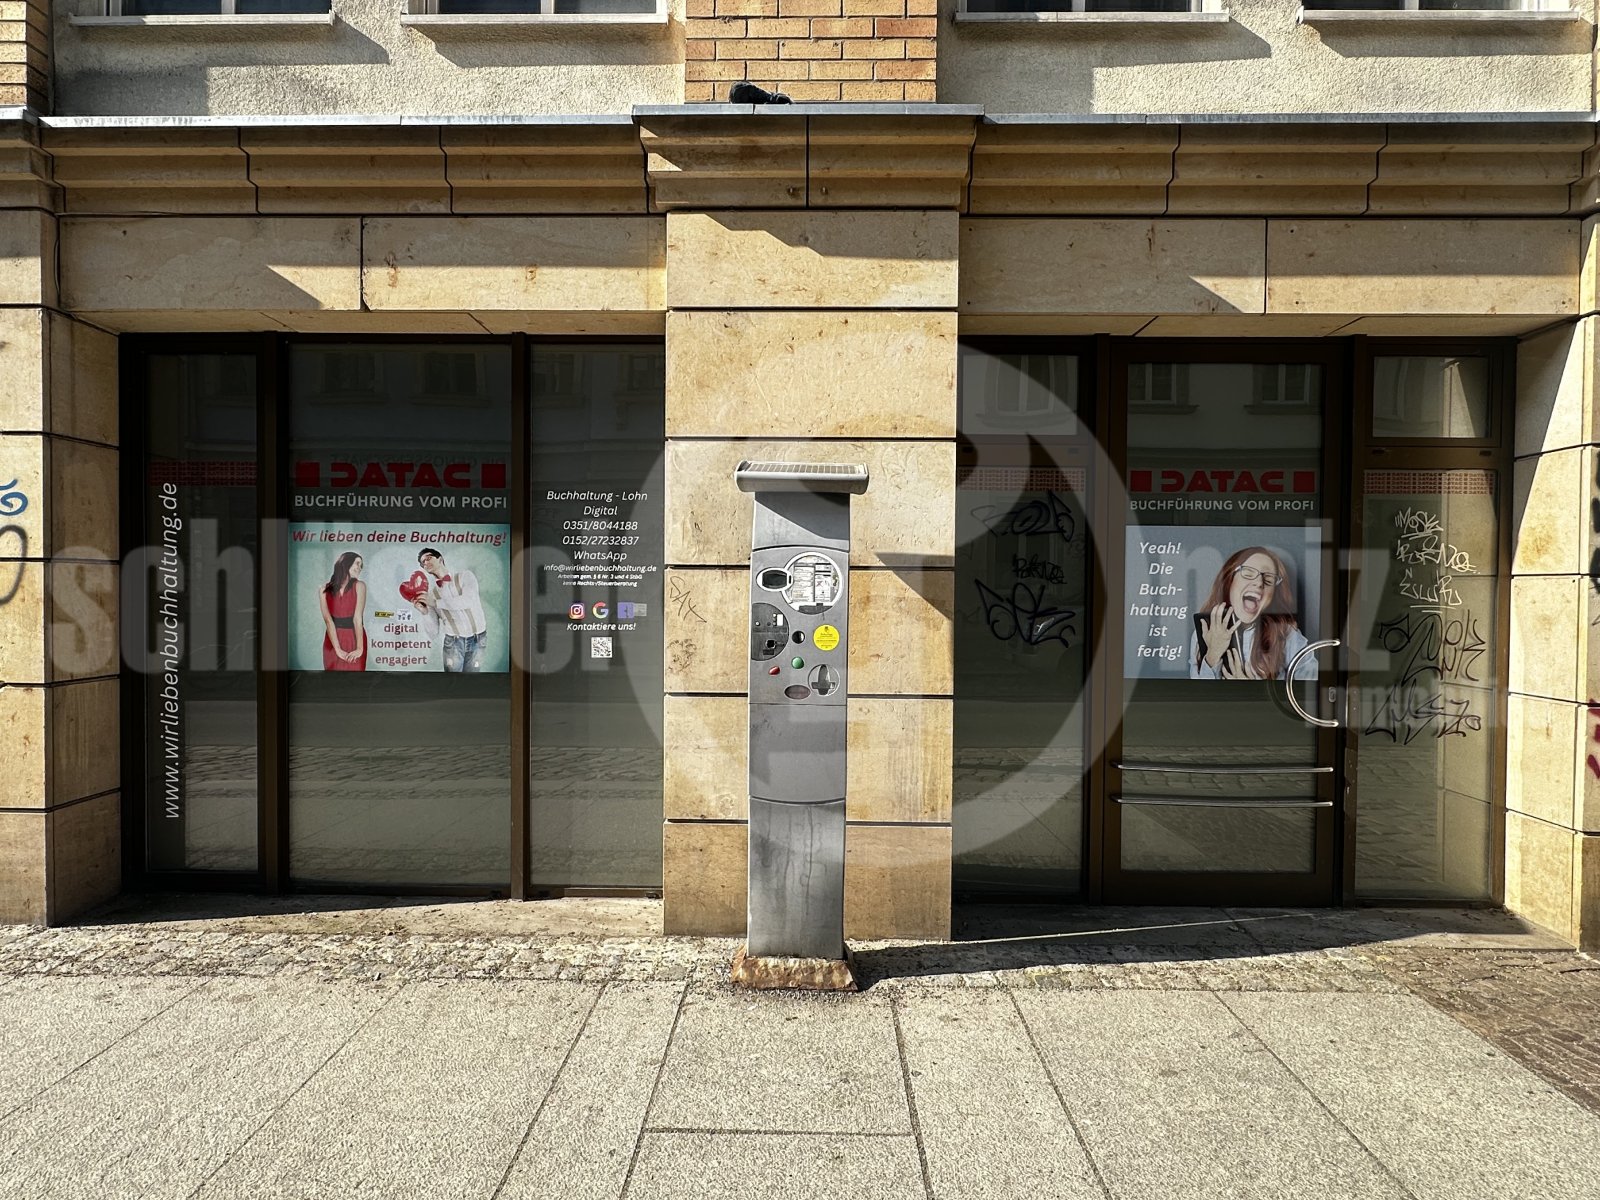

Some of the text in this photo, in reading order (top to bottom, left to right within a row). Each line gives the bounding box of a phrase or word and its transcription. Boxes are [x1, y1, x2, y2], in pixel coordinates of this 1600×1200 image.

[331, 463, 471, 488] DATAC
[1161, 471, 1284, 493] DATAC
[295, 493, 507, 508] BUCHFÜHRUNG VOM PROFI
[546, 491, 613, 502] Buchhaltung
[622, 491, 648, 501] Lohn
[1130, 498, 1314, 511] BUCHFÜHRUNG VOM PROFI
[583, 506, 618, 517] Digital
[563, 521, 638, 531] 0351/8044188
[292, 530, 507, 547] Wir lieben deine Buchhaltung!
[562, 536, 639, 546] 0152/27232837
[1140, 541, 1181, 554] Yeah!
[573, 551, 627, 562] WhatsApp
[544, 564, 657, 573] info@wirliebenbuchhaltung.de
[1149, 562, 1174, 575] Die
[1139, 583, 1183, 595] Buch-
[1130, 604, 1188, 620] haltung
[384, 623, 419, 635] digital
[567, 622, 637, 631] Kontaktiere uns!
[1149, 624, 1168, 637] ist
[158, 482, 182, 819] www.wirliebenbuchhaltung.de
[371, 639, 432, 650] kompetent
[1137, 645, 1183, 660] fertig!
[375, 655, 428, 666] engagiert
